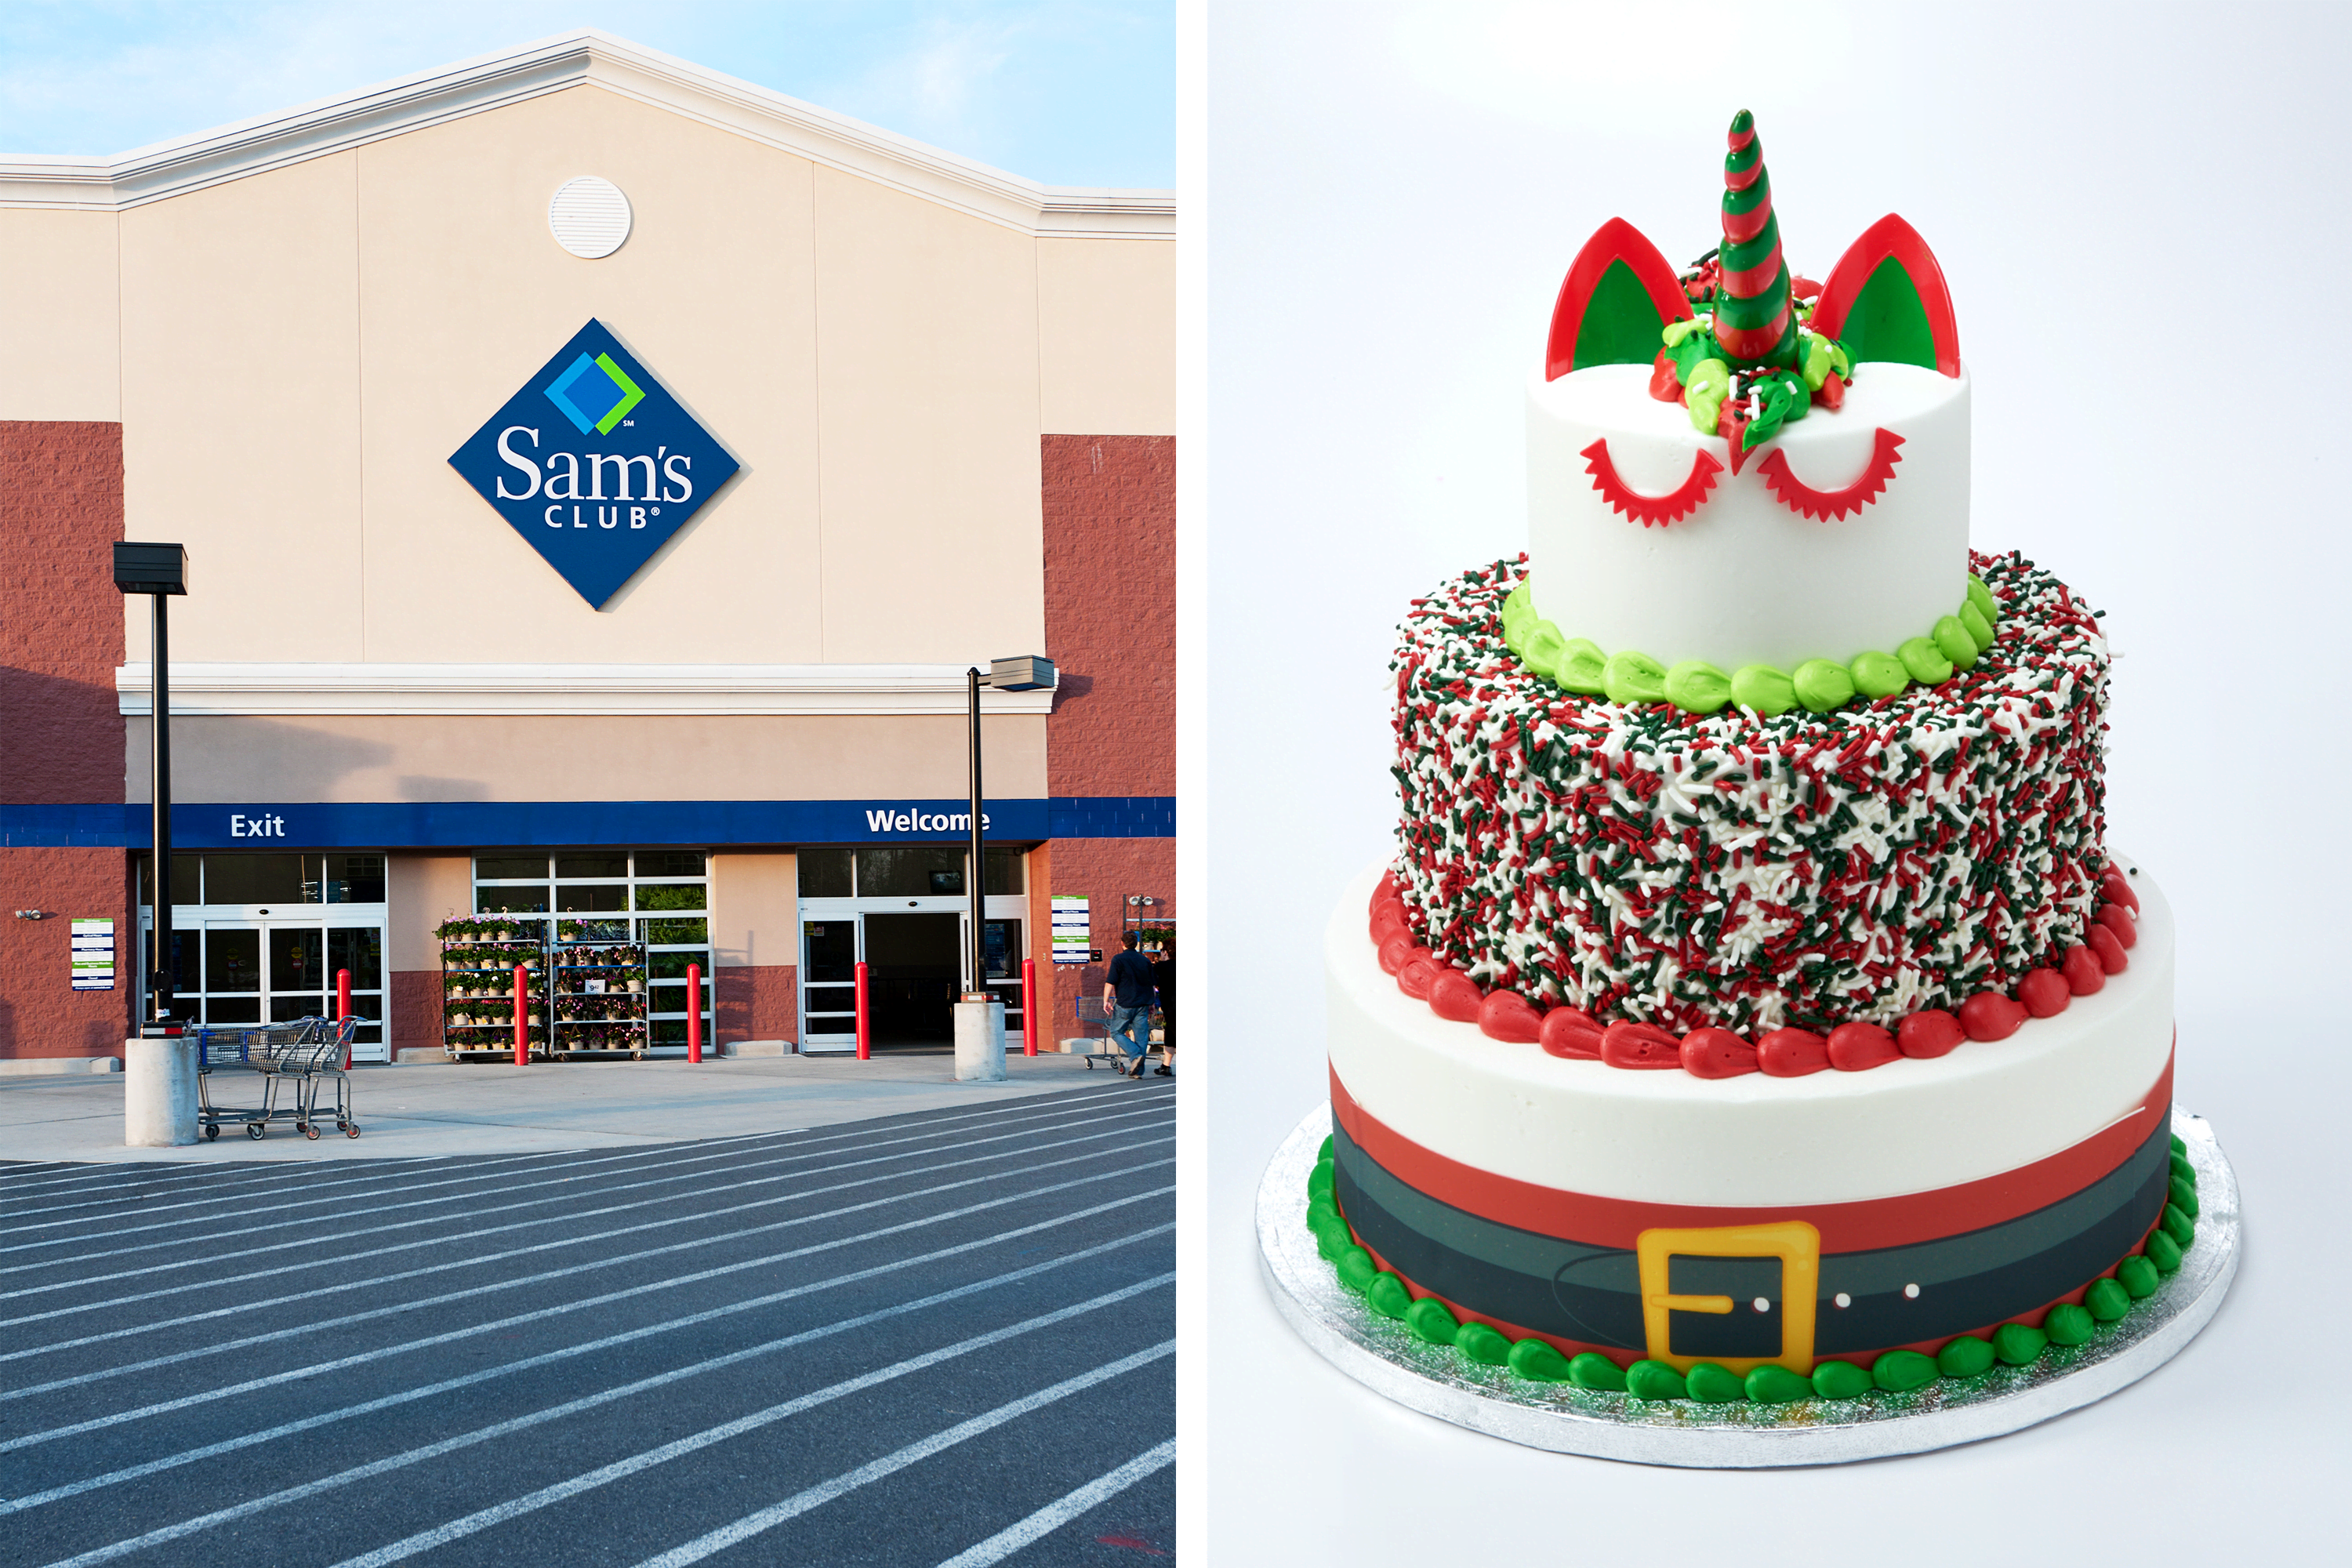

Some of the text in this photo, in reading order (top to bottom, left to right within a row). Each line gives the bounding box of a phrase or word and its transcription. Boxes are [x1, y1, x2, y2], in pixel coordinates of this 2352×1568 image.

[497, 426, 692, 503] Sam's
[231, 813, 285, 837] Exit
[866, 808, 990, 833] Welcome
